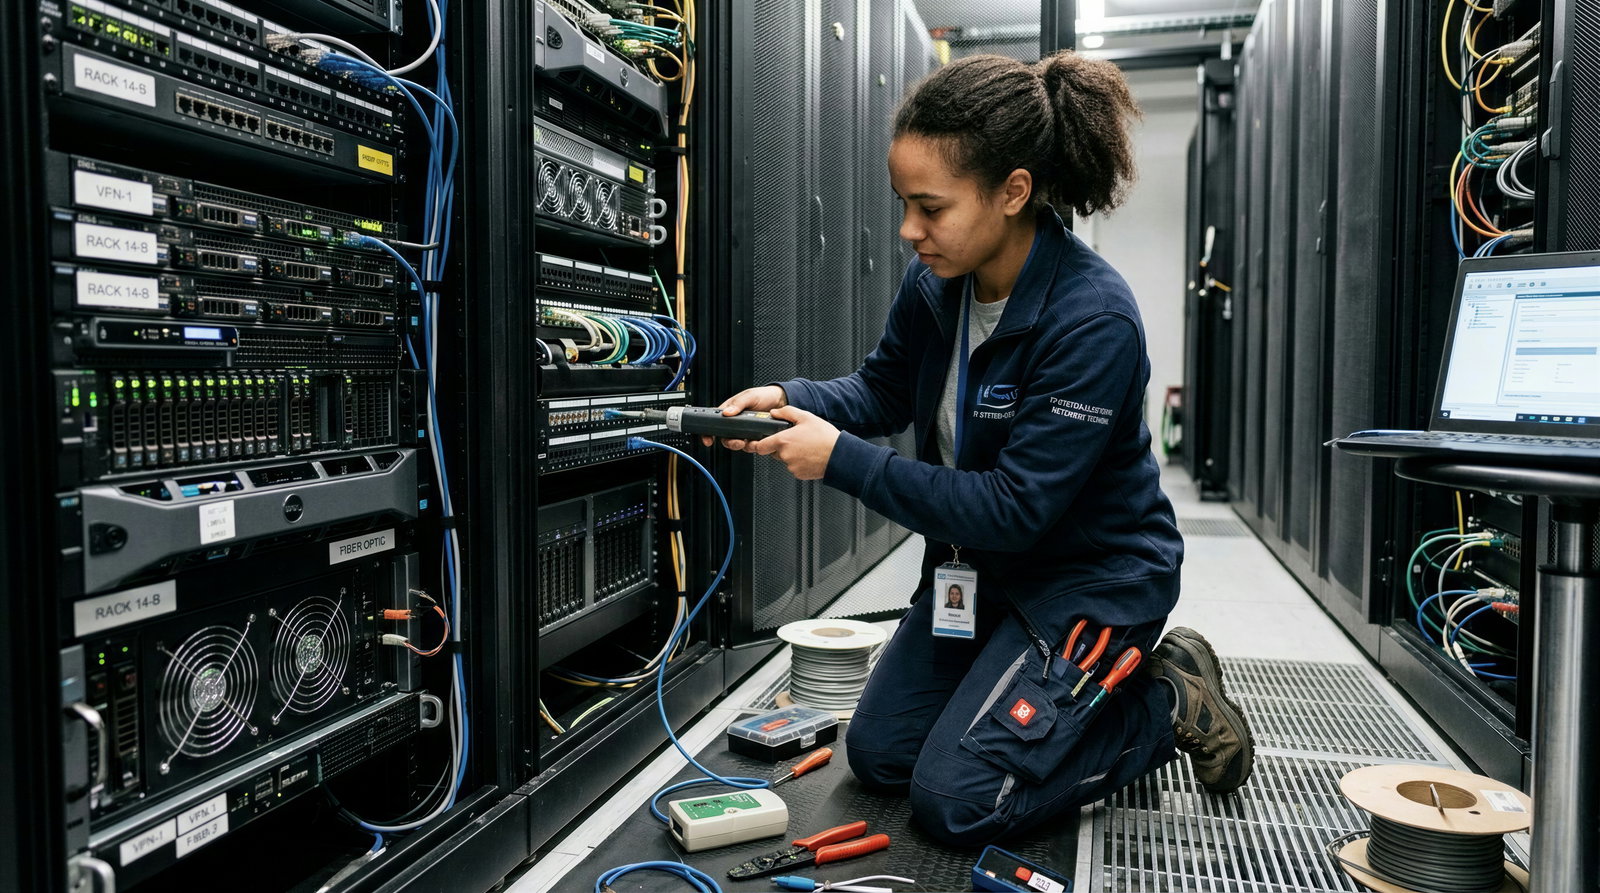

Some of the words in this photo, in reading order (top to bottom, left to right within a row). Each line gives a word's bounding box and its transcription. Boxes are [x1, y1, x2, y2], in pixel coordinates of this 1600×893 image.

[84, 67, 120, 88] RACK
[86, 234, 121, 251] RACK
[87, 282, 122, 297] RACK
[363, 535, 386, 550] OPTIC
[95, 600, 132, 620] RACK
